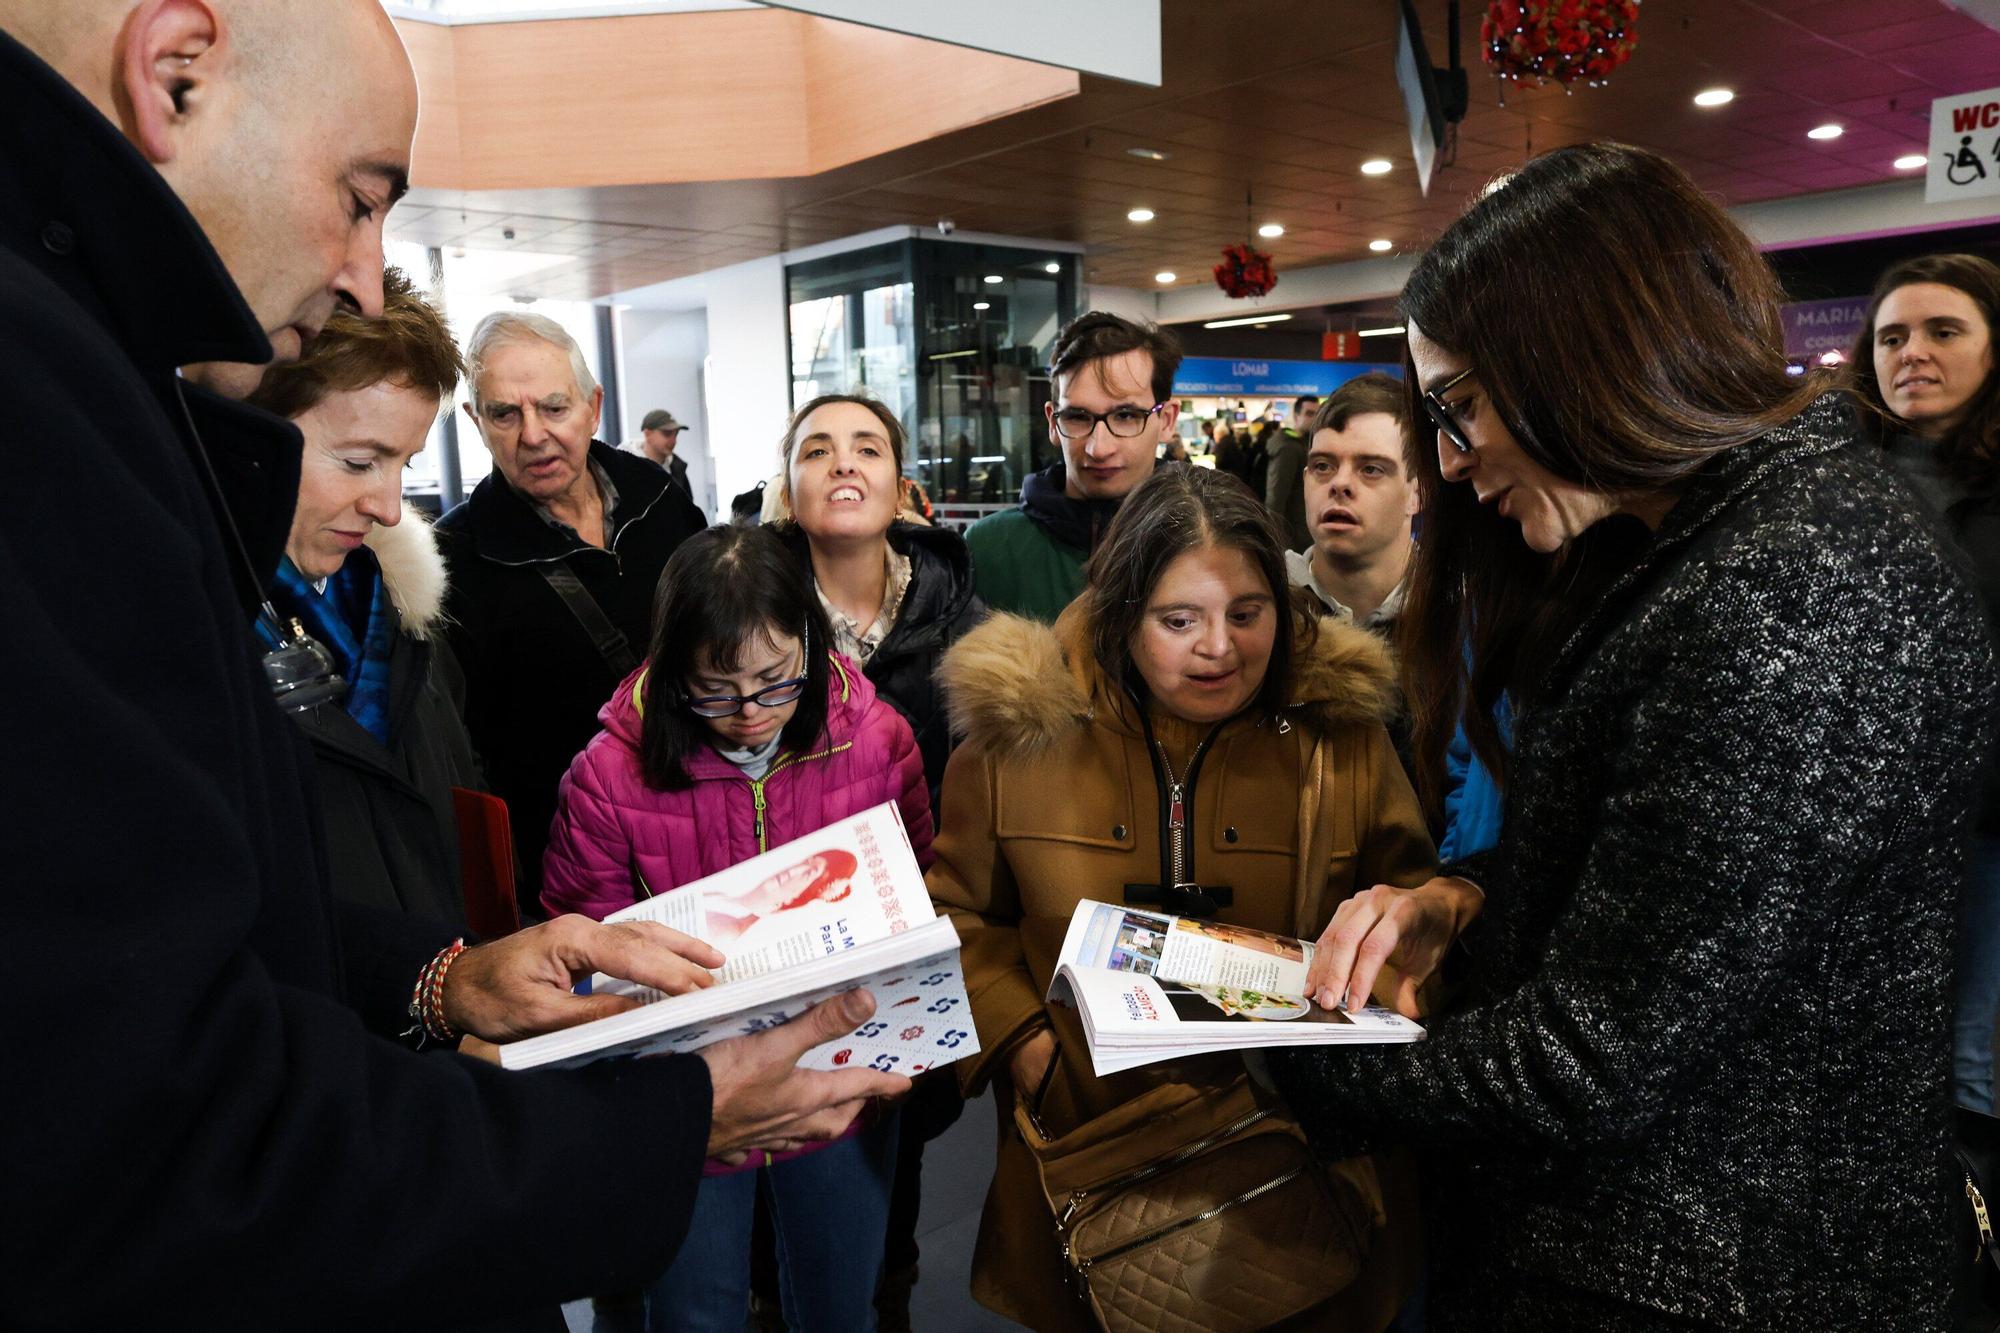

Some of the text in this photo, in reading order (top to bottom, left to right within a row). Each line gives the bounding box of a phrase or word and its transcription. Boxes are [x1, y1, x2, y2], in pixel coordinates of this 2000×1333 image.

[1953, 102, 2000, 133] WC
[819, 924, 835, 955] Para
[837, 918, 848, 934] La
